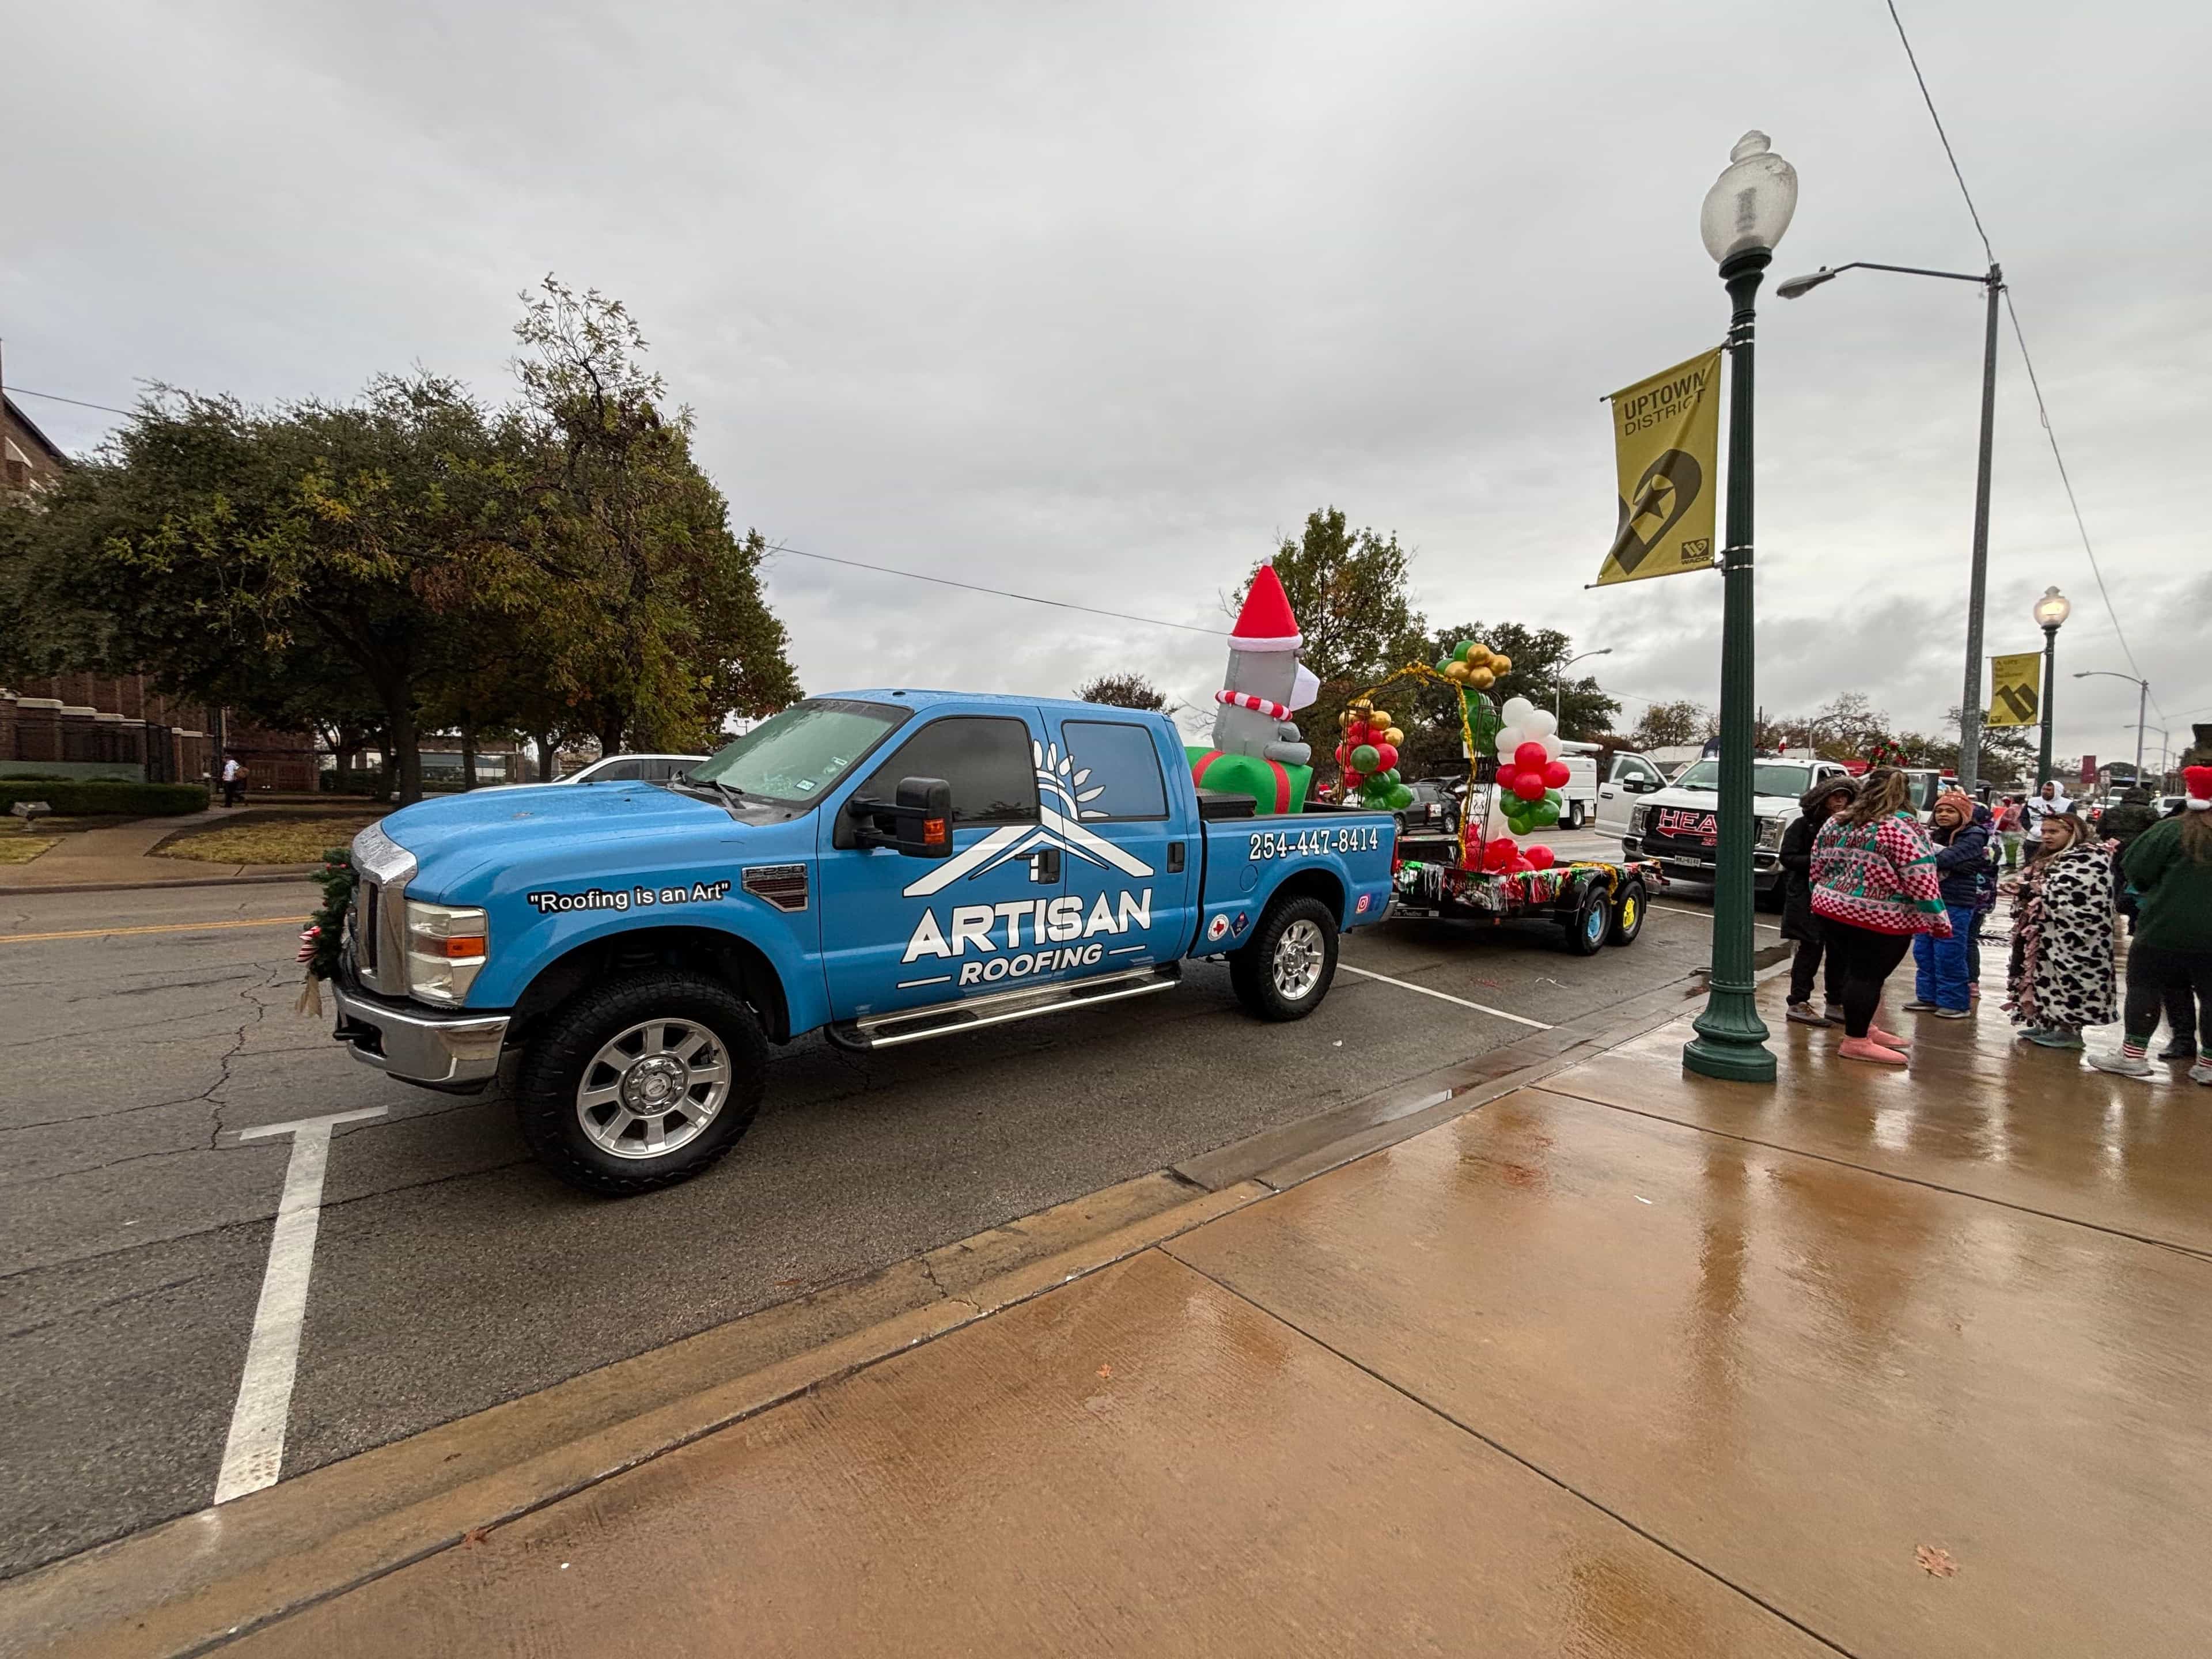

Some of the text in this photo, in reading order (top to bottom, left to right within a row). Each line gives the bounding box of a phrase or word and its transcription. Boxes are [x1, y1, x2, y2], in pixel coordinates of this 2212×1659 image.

[1623, 369, 1706, 420] UPTOWN
[1625, 388, 1706, 437] DISTRICT
[1658, 808, 1717, 834] HEA
[1249, 827, 1378, 861] 254-447-8414
[530, 883, 728, 912] "Roofing is an Art"
[901, 888, 1152, 964] ARTISAN
[958, 944, 1103, 987] ROOFING
